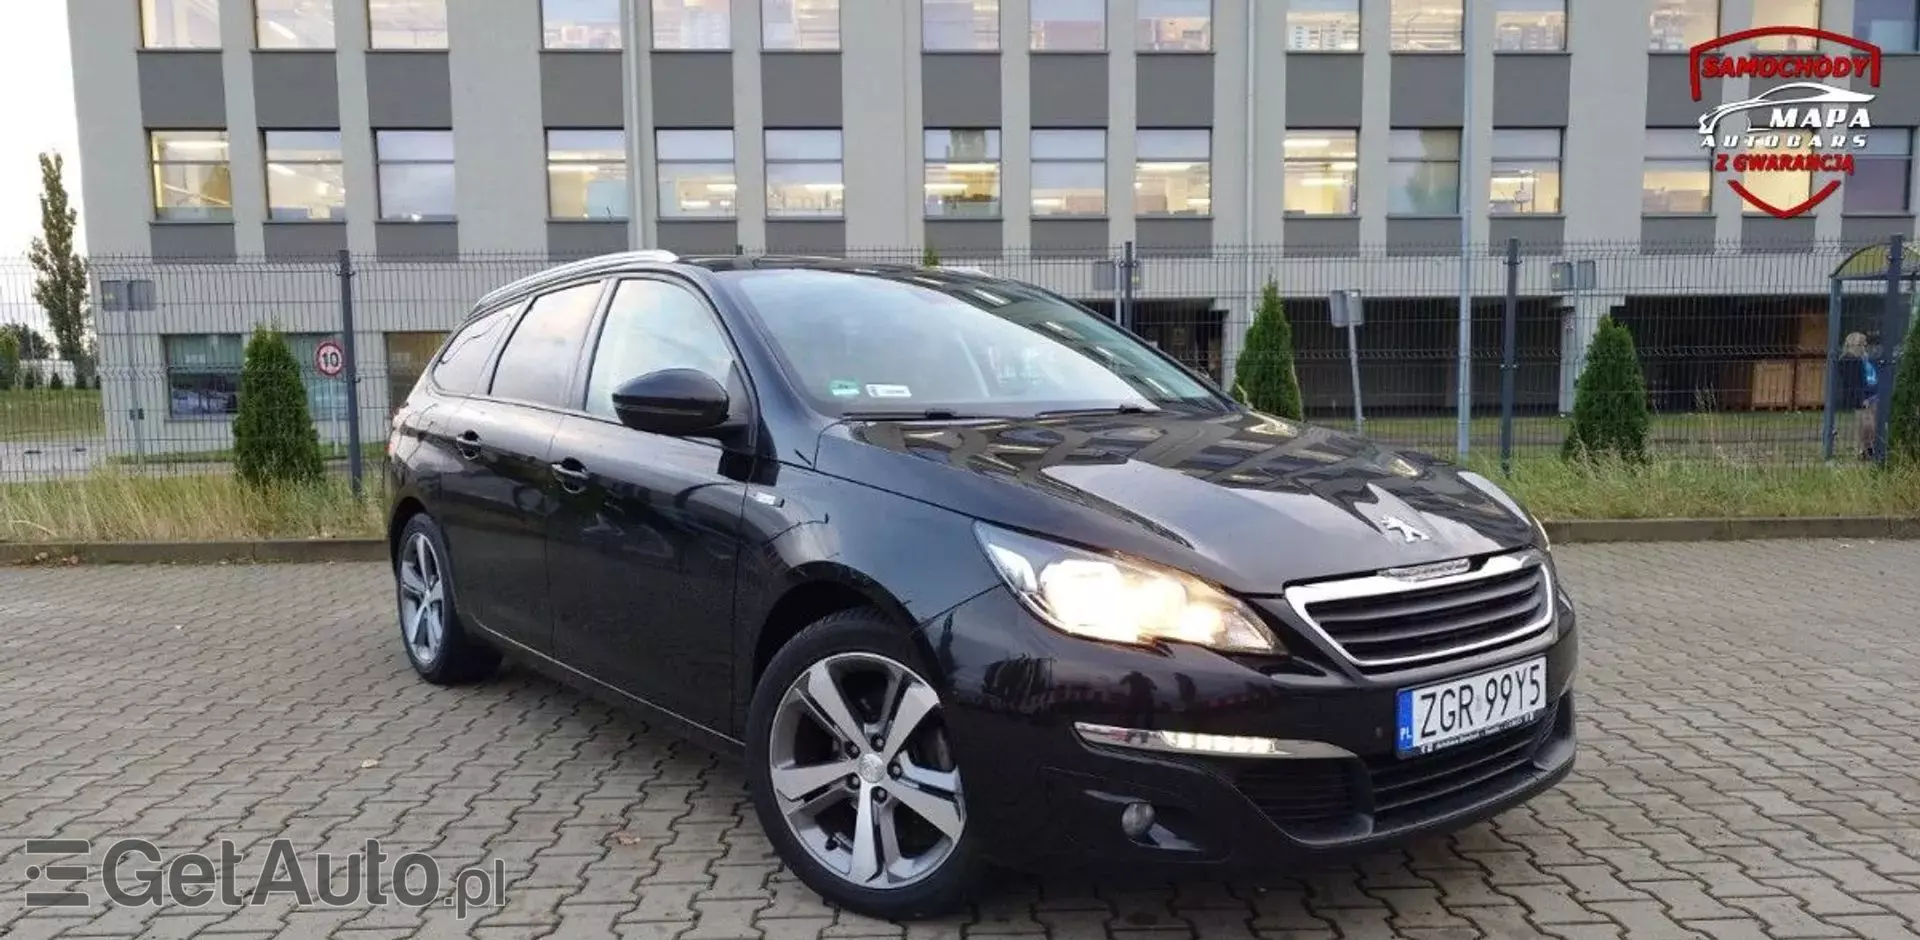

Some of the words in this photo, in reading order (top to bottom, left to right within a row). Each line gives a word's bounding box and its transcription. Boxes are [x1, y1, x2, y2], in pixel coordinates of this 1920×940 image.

[322, 352, 339, 368] 10
[1421, 684, 1474, 738] ZGR
[1485, 664, 1540, 721] 99Y5
[1400, 728, 1412, 740] PL
